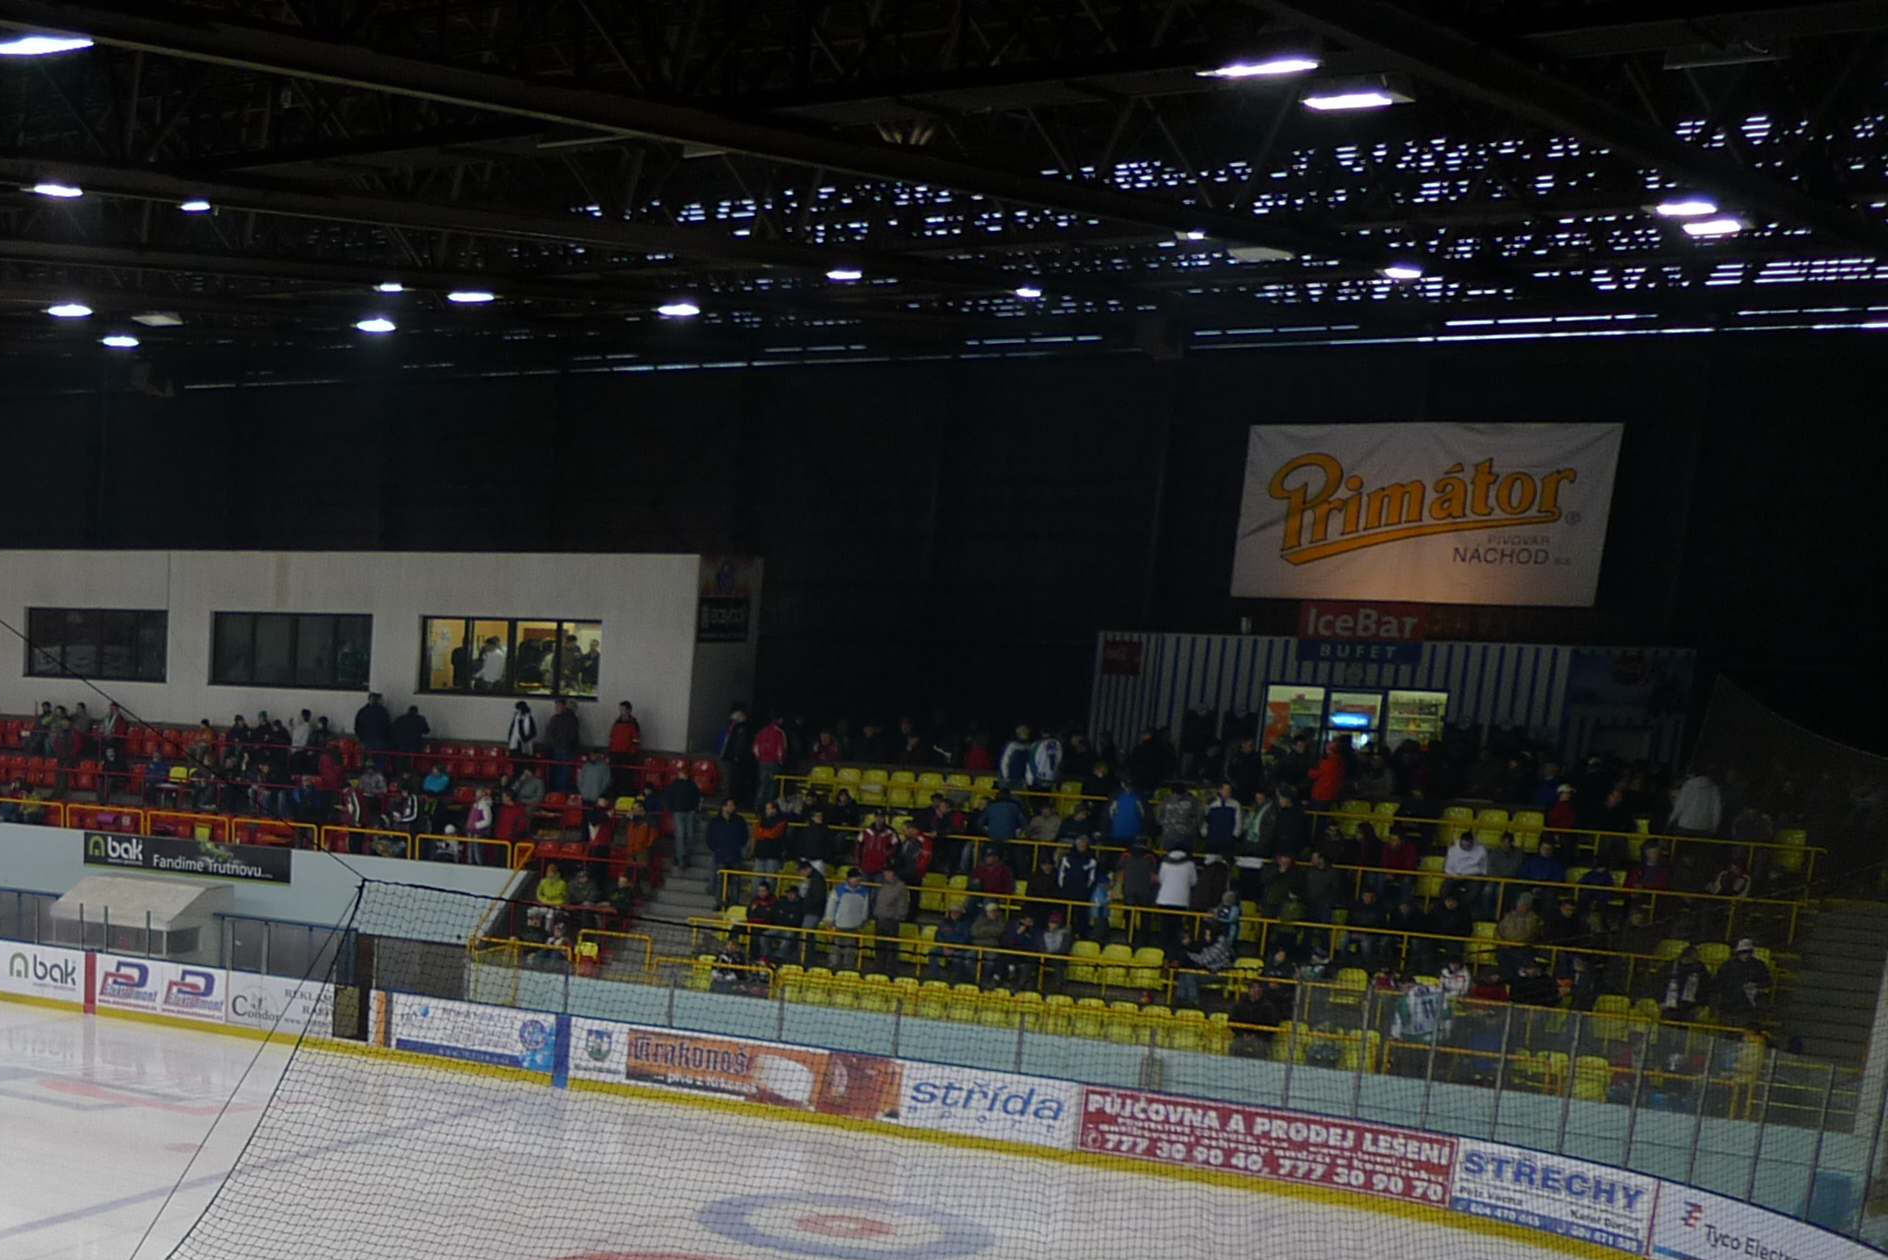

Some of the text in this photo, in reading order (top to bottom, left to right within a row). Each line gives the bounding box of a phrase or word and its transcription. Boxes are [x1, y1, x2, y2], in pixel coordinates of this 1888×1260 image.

[1268, 452, 1576, 550] Primátor
[1452, 542, 1549, 566] NÁCHOD
[1487, 533, 1550, 547] PIVOVAR
[1305, 606, 1420, 639] IceBar
[1319, 643, 1398, 660] BUFET
[107, 836, 144, 861] bak
[152, 854, 205, 873] Fandíme
[33, 953, 77, 986] bak
[633, 1036, 748, 1075] Krakonoš
[910, 1080, 1064, 1124] střída
[1087, 1090, 1221, 1130] PŮJČOVNA
[1227, 1114, 1246, 1134] A
[1253, 1117, 1355, 1149] PRODEJ
[1362, 1133, 1451, 1166] LEŠENÍ
[1104, 1133, 1150, 1154] 777
[1155, 1142, 1187, 1161] 30
[1193, 1146, 1224, 1167] 90
[1277, 1158, 1328, 1180] 777
[1333, 1167, 1366, 1188] 30
[1372, 1173, 1405, 1195] 90
[1411, 1179, 1445, 1202] 70
[1463, 1150, 1647, 1211] STŘECHY
[1705, 1223, 1742, 1252] Tyco
